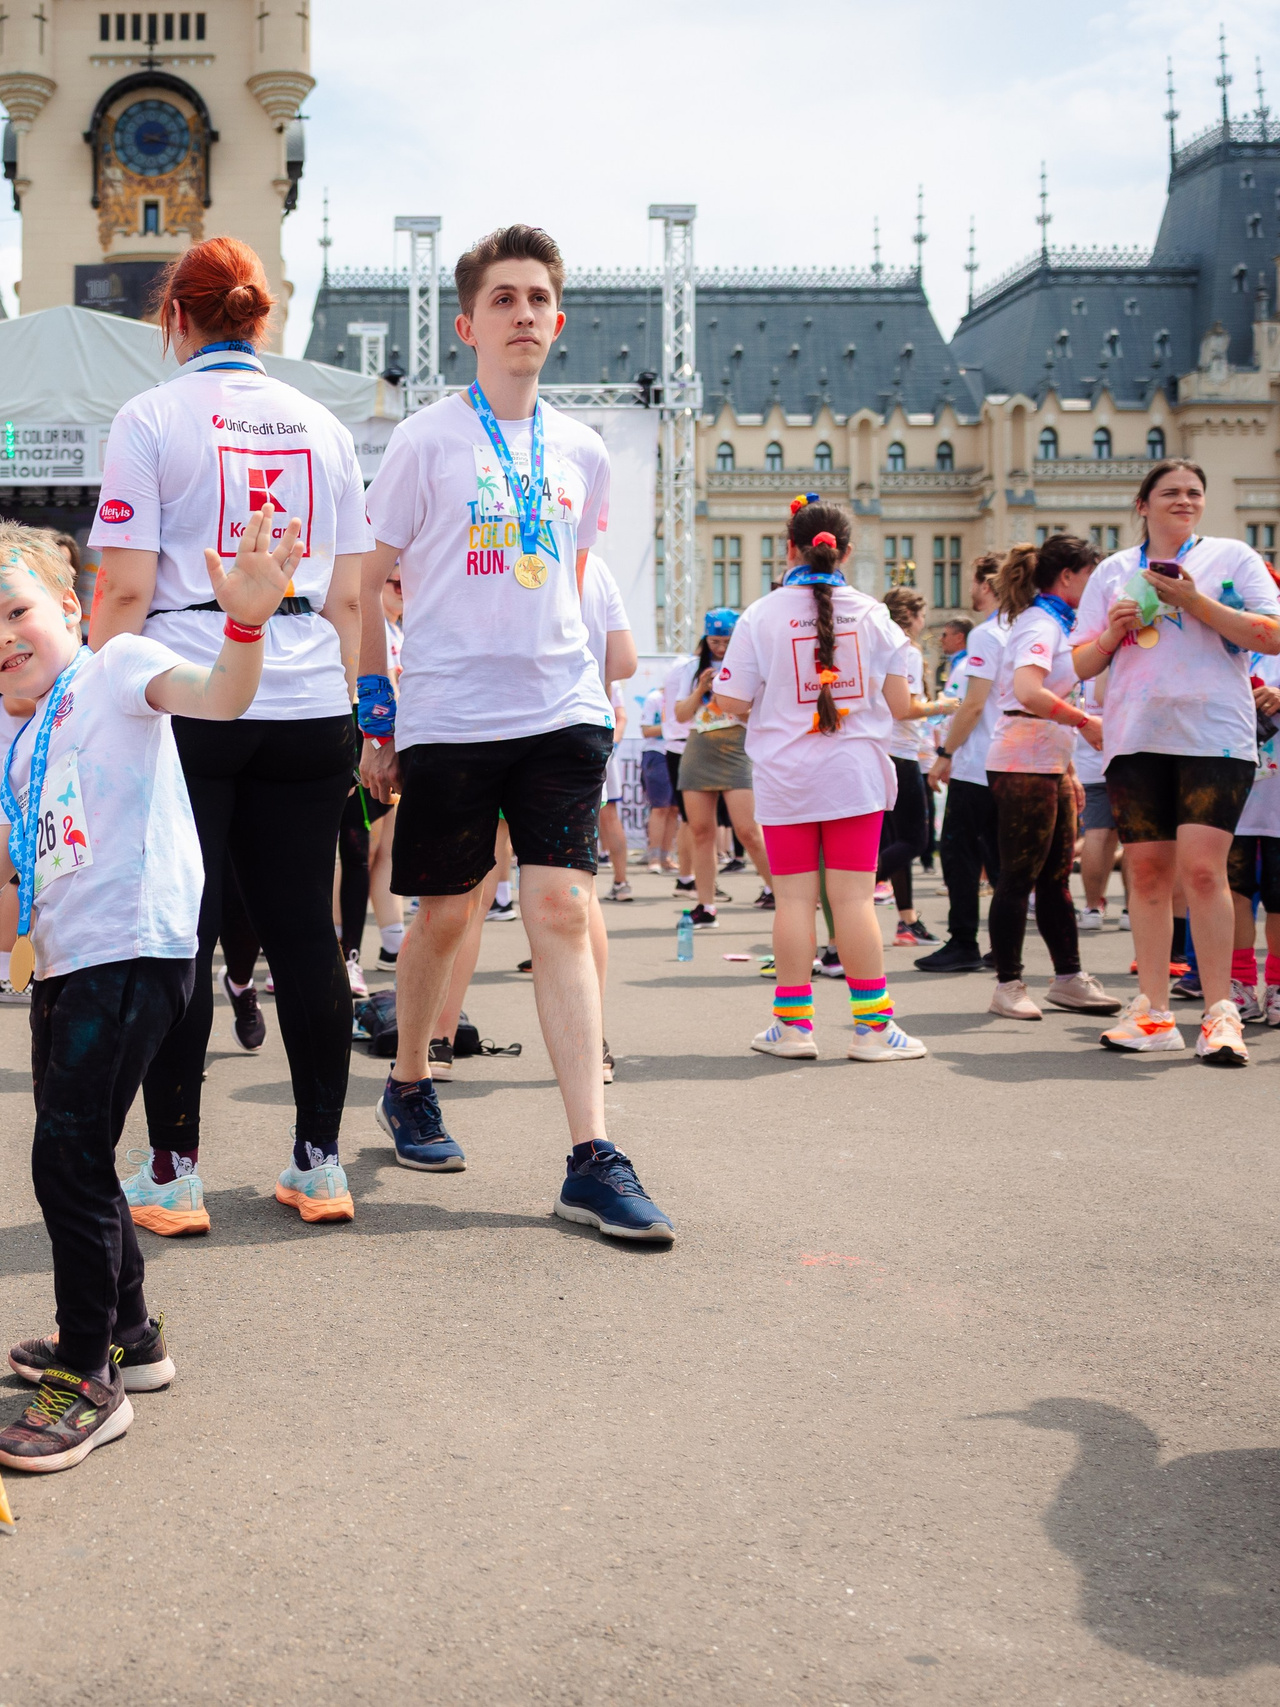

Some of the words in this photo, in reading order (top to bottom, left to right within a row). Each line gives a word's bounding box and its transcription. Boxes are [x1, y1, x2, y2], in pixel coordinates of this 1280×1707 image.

[225, 419, 274, 435] UniCredit
[277, 422, 308, 435] Bank
[23, 430, 60, 445] COLOR
[0, 446, 84, 465] amazing
[11, 464, 50, 477] tour
[101, 505, 131, 519] Hervis
[836, 617, 858, 625] Bank
